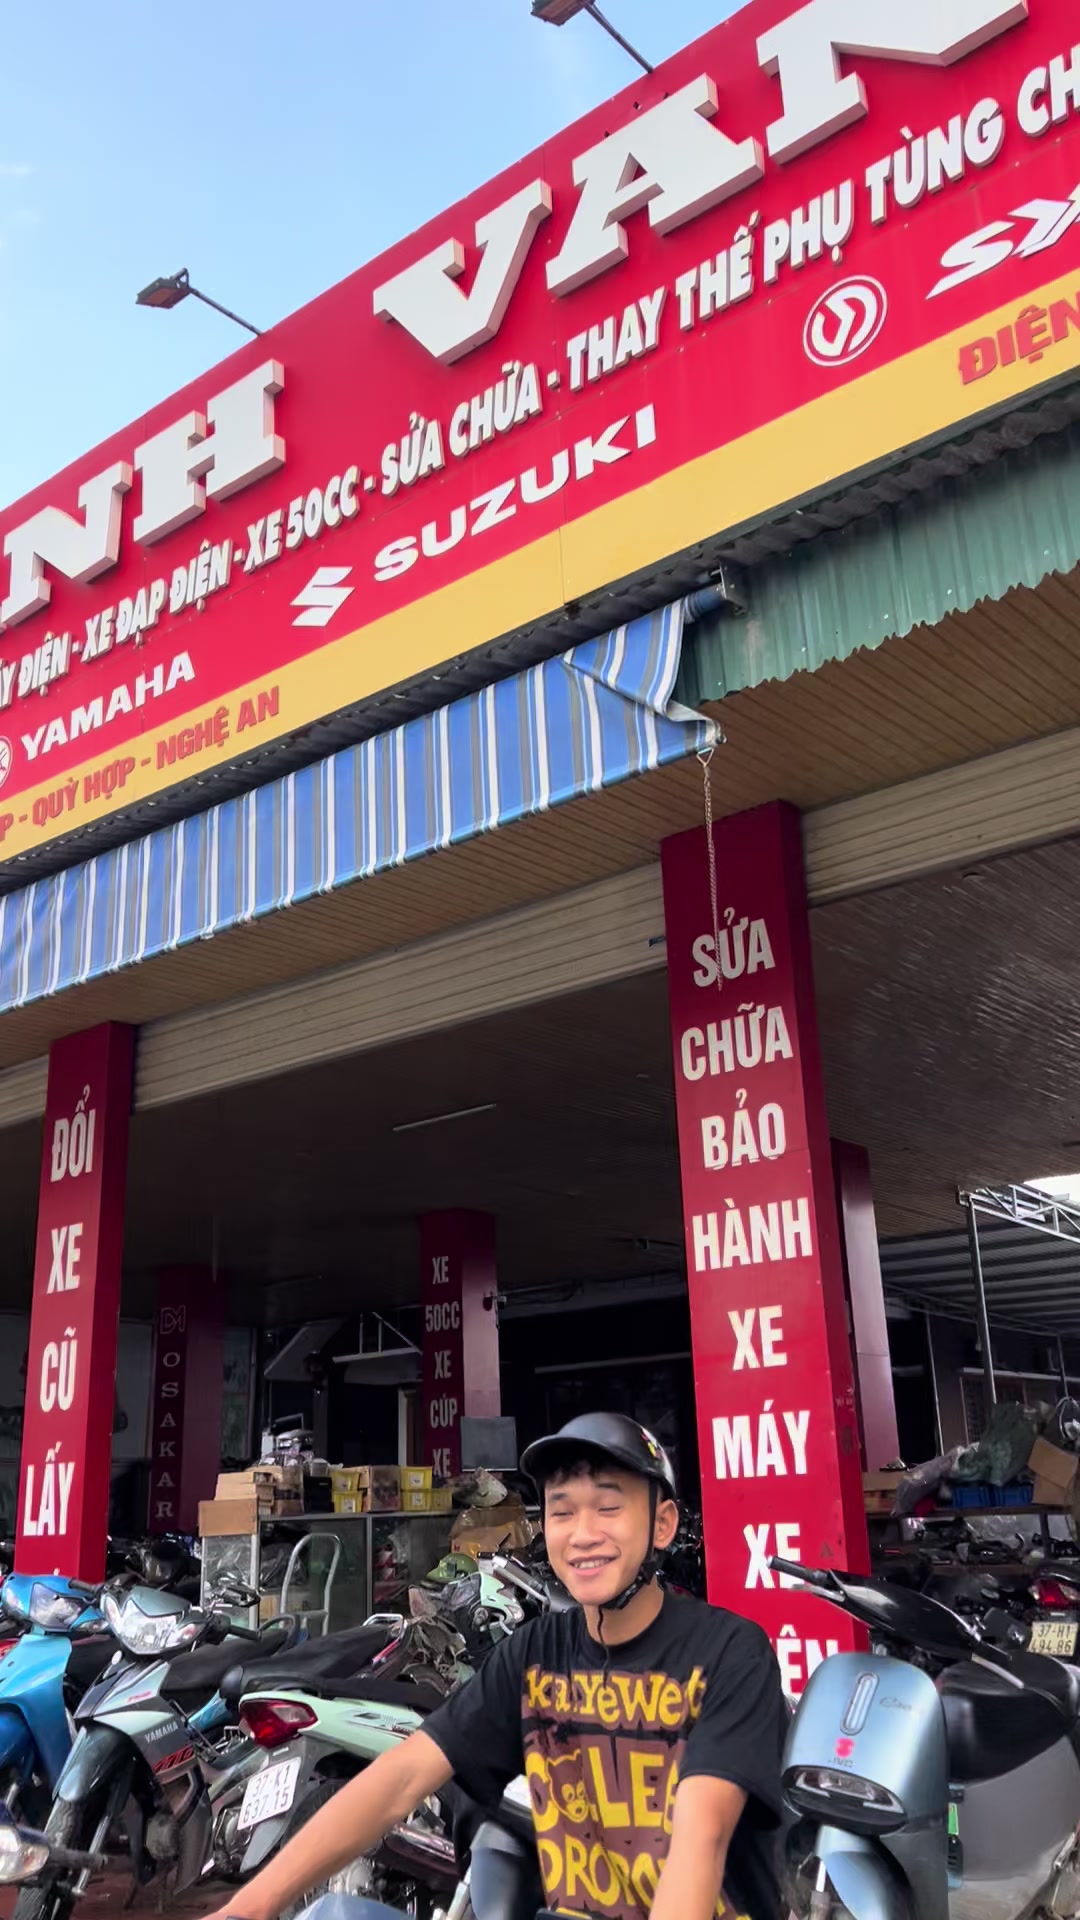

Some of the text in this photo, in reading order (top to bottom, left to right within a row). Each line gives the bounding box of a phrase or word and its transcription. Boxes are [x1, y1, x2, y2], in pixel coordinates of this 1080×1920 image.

[18, 632, 73, 698] ĐIỆN
[81, 606, 117, 664] XE
[116, 578, 168, 648] ĐẠP
[170, 539, 233, 615] ĐIỆN
[243, 508, 286, 574] XE
[285, 465, 361, 550] 50CC
[381, 411, 446, 496] SỬA
[449, 360, 543, 457] CHỮA
[567, 285, 667, 391] THAY
[675, 211, 761, 331] THẾ
[763, 178, 856, 283] PHỤ
[865, 97, 1005, 226] TÙNG
[374, 403, 657, 582] SUZUKI
[21, 650, 195, 761] YAMAHA
[83, 755, 136, 803] HỢP
[156, 706, 230, 770] NGHỆ
[236, 685, 280, 733] AN
[692, 906, 776, 988] SỬA
[680, 1002, 794, 1082] CHỮA
[50, 1083, 96, 1182] ĐỔI
[701, 1088, 786, 1170] BẢO
[46, 1223, 83, 1294] XE
[432, 1256, 449, 1284] XE
[692, 1196, 813, 1272] HÀNH
[425, 1301, 460, 1332] 50CC
[728, 1304, 788, 1371] XE
[39, 1327, 78, 1413] CŨ
[434, 1351, 451, 1379] XE
[430, 1393, 457, 1429] CÚP
[712, 1399, 811, 1480] MÁY
[23, 1441, 75, 1538] LẤY
[433, 1448, 450, 1477] XE
[743, 1523, 801, 1589] XE
[145, 1721, 179, 1744] YAMAHA
